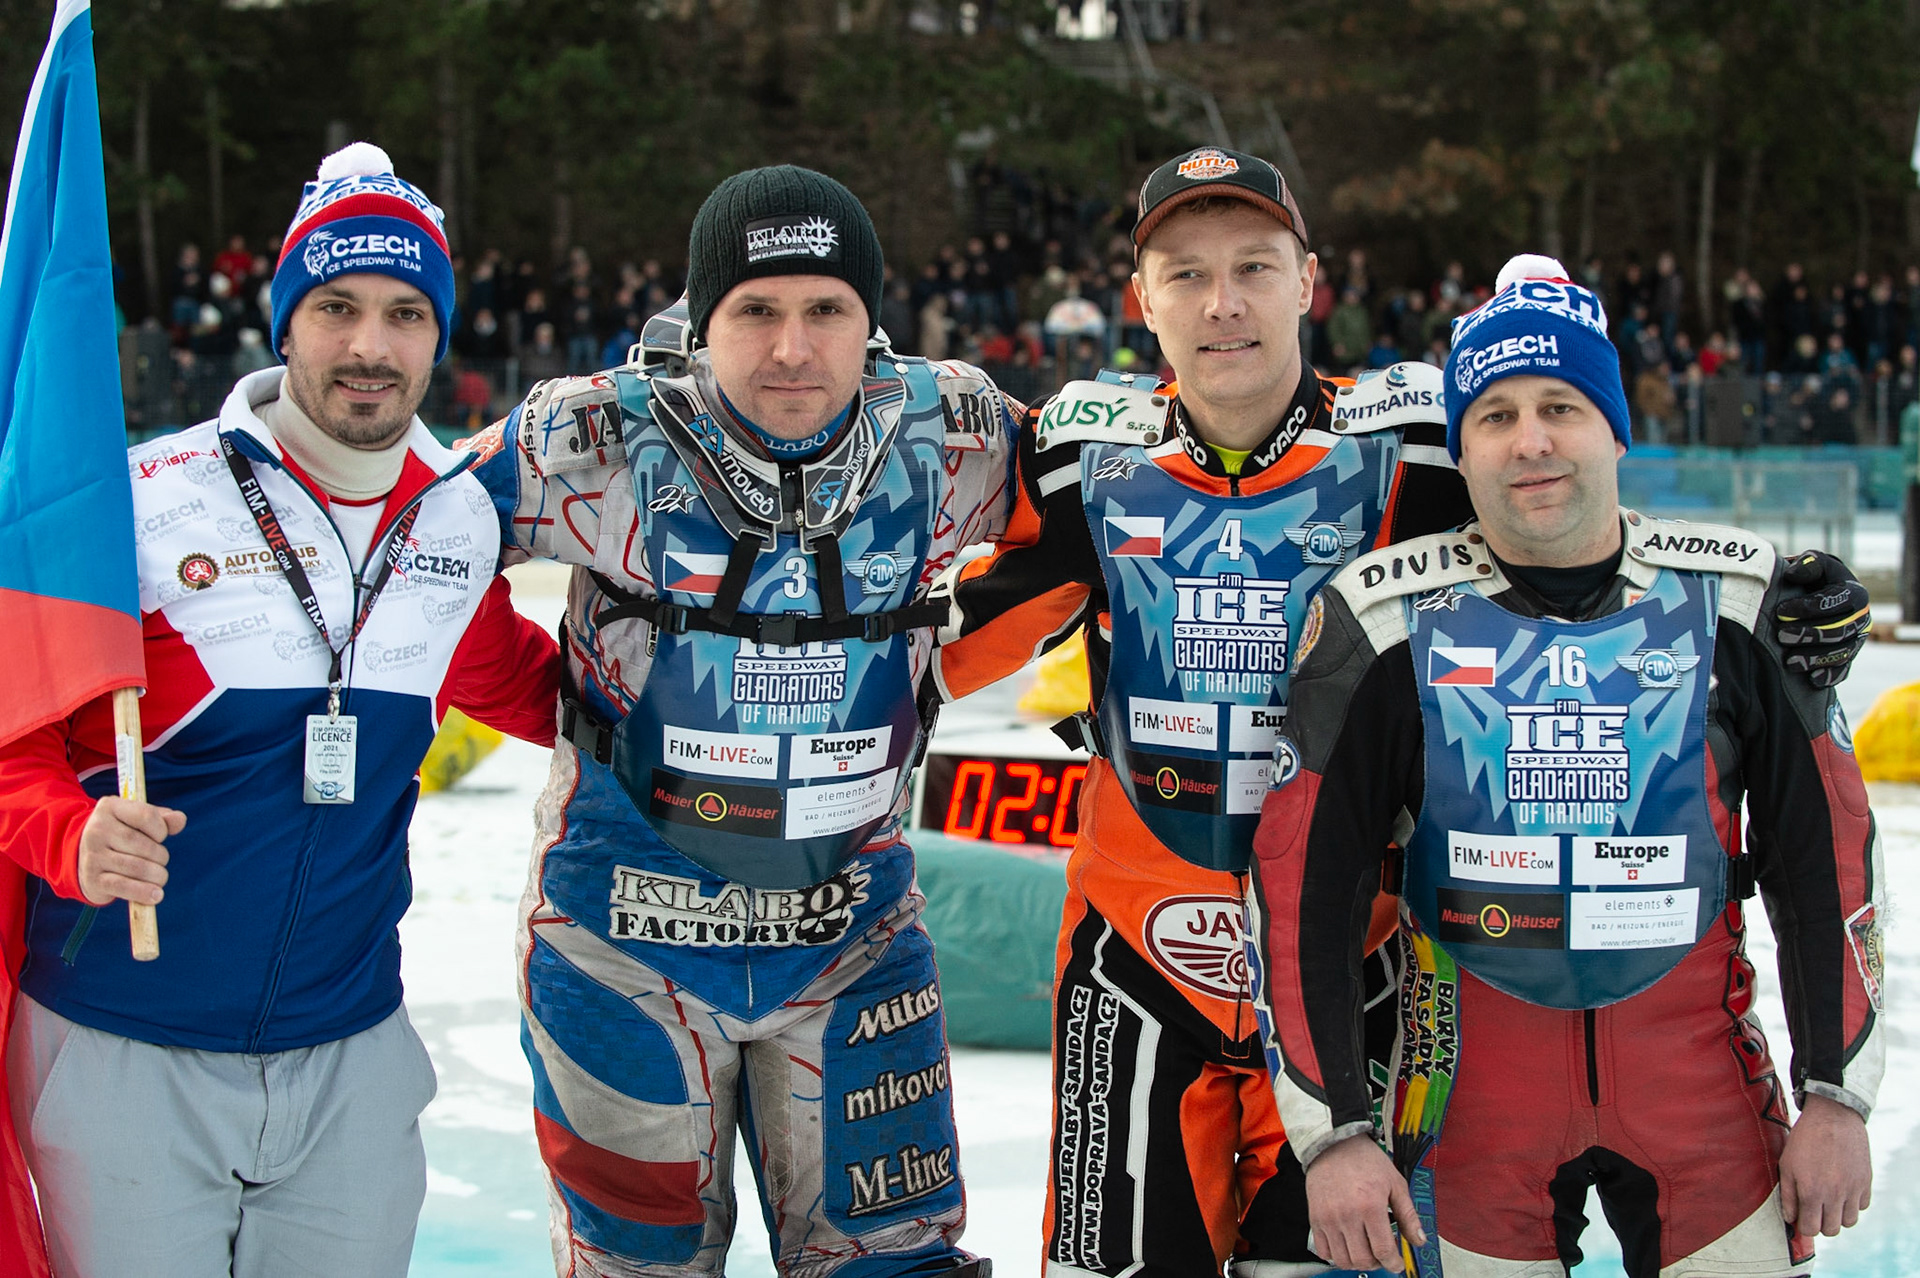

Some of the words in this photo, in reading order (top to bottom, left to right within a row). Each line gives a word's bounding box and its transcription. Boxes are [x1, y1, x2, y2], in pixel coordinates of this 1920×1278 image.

[1179, 157, 1237, 174] HUTLA
[332, 234, 422, 260] CZECH
[326, 262, 341, 275] ICE
[343, 256, 396, 270] SPEEDWAY
[399, 258, 422, 273] TEAM
[1473, 334, 1559, 372] CZECH
[1473, 376, 1484, 389] ICE
[1483, 357, 1531, 378] SPEEDWAY
[1535, 357, 1560, 367] TEAM
[1039, 397, 1130, 435] KUSÝ
[525, 409, 538, 479] design
[1253, 405, 1308, 468] WACO
[844, 441, 872, 481] moveo
[720, 452, 775, 517] moveo
[144, 498, 206, 533] CZECH
[429, 533, 472, 554] CZECH
[1217, 519, 1244, 561] 4
[1310, 535, 1338, 553] FIM
[225, 546, 319, 570] AUTOUB
[413, 553, 470, 581] CZECH
[1359, 544, 1473, 589] DIVIS
[410, 573, 422, 584] ICE
[423, 576, 450, 588] SPEEDWAY
[452, 581, 469, 592] TEAM
[783, 556, 808, 599] 3
[869, 563, 894, 582] FIM
[1220, 574, 1242, 586] FIM
[437, 595, 469, 617] CZECH
[1174, 587, 1288, 624] ICE
[203, 612, 270, 641] CZECH
[1177, 626, 1283, 639] SPEEDWAY
[382, 641, 428, 664] CZECH
[737, 660, 843, 672] SPEEDWAY
[1541, 645, 1587, 688] 16
[1643, 659, 1674, 677] FIM
[1185, 670, 1200, 692] OF
[743, 704, 762, 725] OF
[1556, 700, 1580, 713] FIM
[312, 732, 353, 743] LICENCE
[1507, 714, 1629, 751] ICE
[810, 735, 877, 755] Europe
[832, 753, 855, 762] Suisse
[1510, 755, 1624, 765] SPEEDWAY
[817, 786, 866, 802] elements
[1181, 778, 1219, 795] Häuser
[653, 787, 695, 809] Mauer
[728, 803, 779, 820] Häuser
[805, 812, 819, 821] BAD
[827, 808, 856, 818] HEIZUNG
[1519, 802, 1538, 824] OF
[1594, 841, 1670, 863] Europe
[1620, 861, 1645, 869] Suisse
[618, 870, 845, 920] KLABO
[1604, 899, 1661, 911] elements
[616, 911, 798, 943] FACTORY
[1441, 908, 1479, 926] Mauer
[1511, 914, 1561, 930] Häuser
[1617, 922, 1650, 930] HEIZUNG
[1657, 919, 1684, 928] ENERGIE
[847, 981, 939, 1046] Mitas
[1434, 980, 1456, 1079] BARVY
[1060, 986, 1091, 1264] WWW.JERABY-SANDA.CZ
[1083, 994, 1119, 1268] WWW.DOPRAVA-SANDA.CZ
[847, 1145, 951, 1209] M-line
